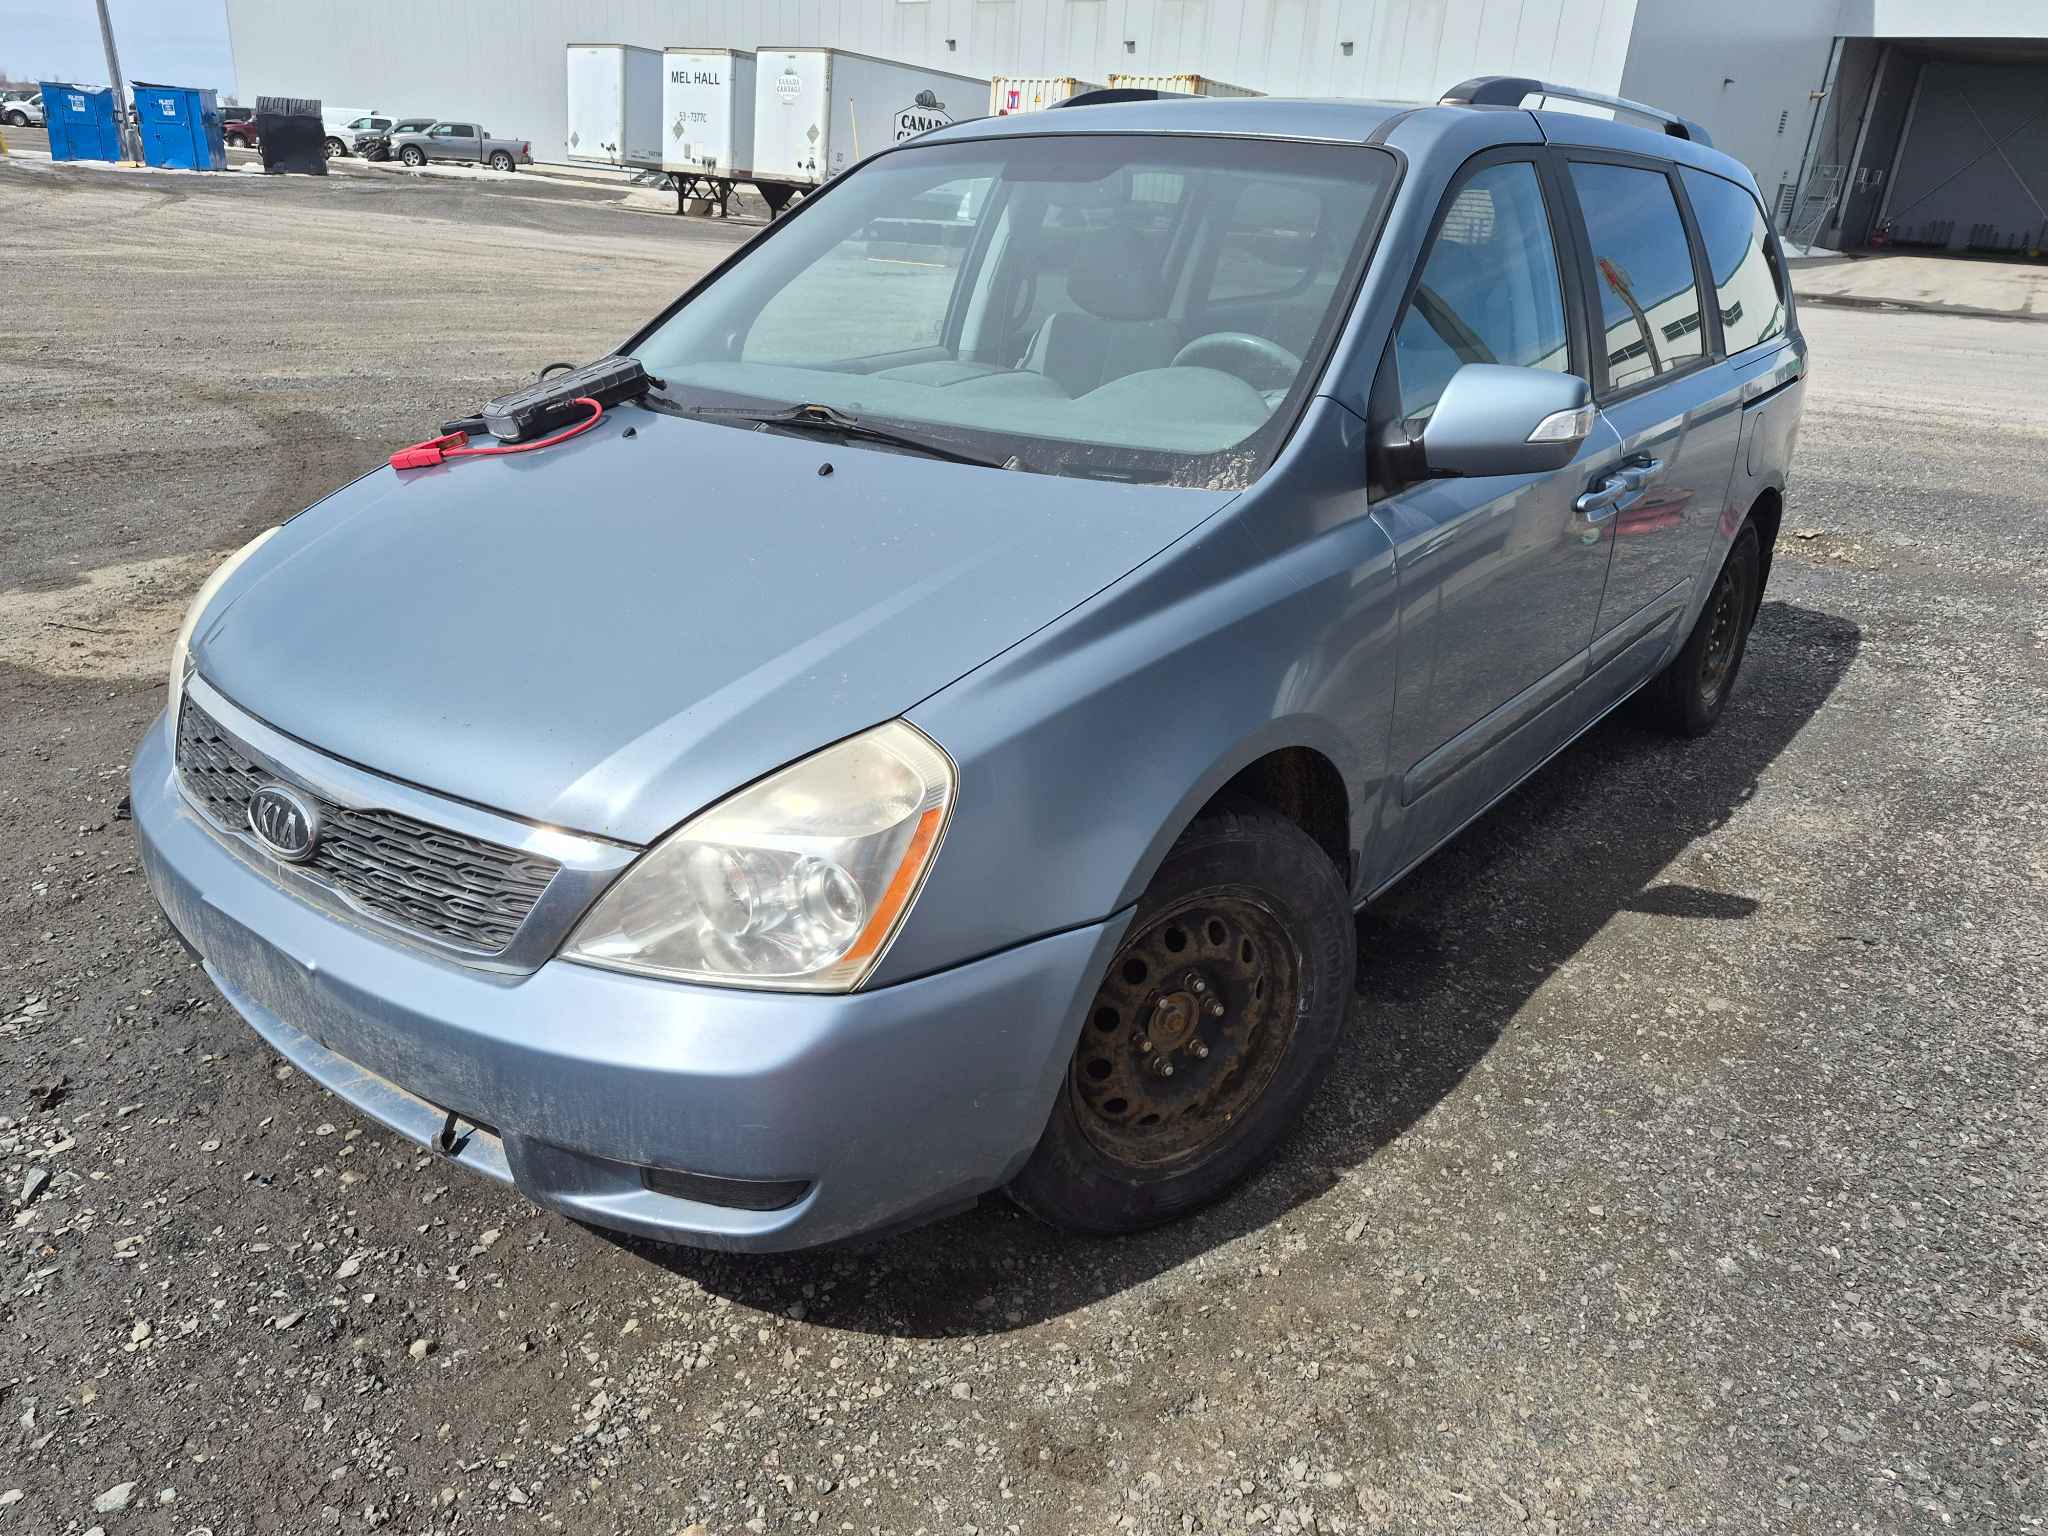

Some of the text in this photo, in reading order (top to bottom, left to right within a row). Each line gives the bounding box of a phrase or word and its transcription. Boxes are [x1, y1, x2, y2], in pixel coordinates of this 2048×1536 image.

[671, 71, 720, 85] MEL HALL
[901, 114, 949, 132] CANAD
[256, 796, 297, 849] KIA
